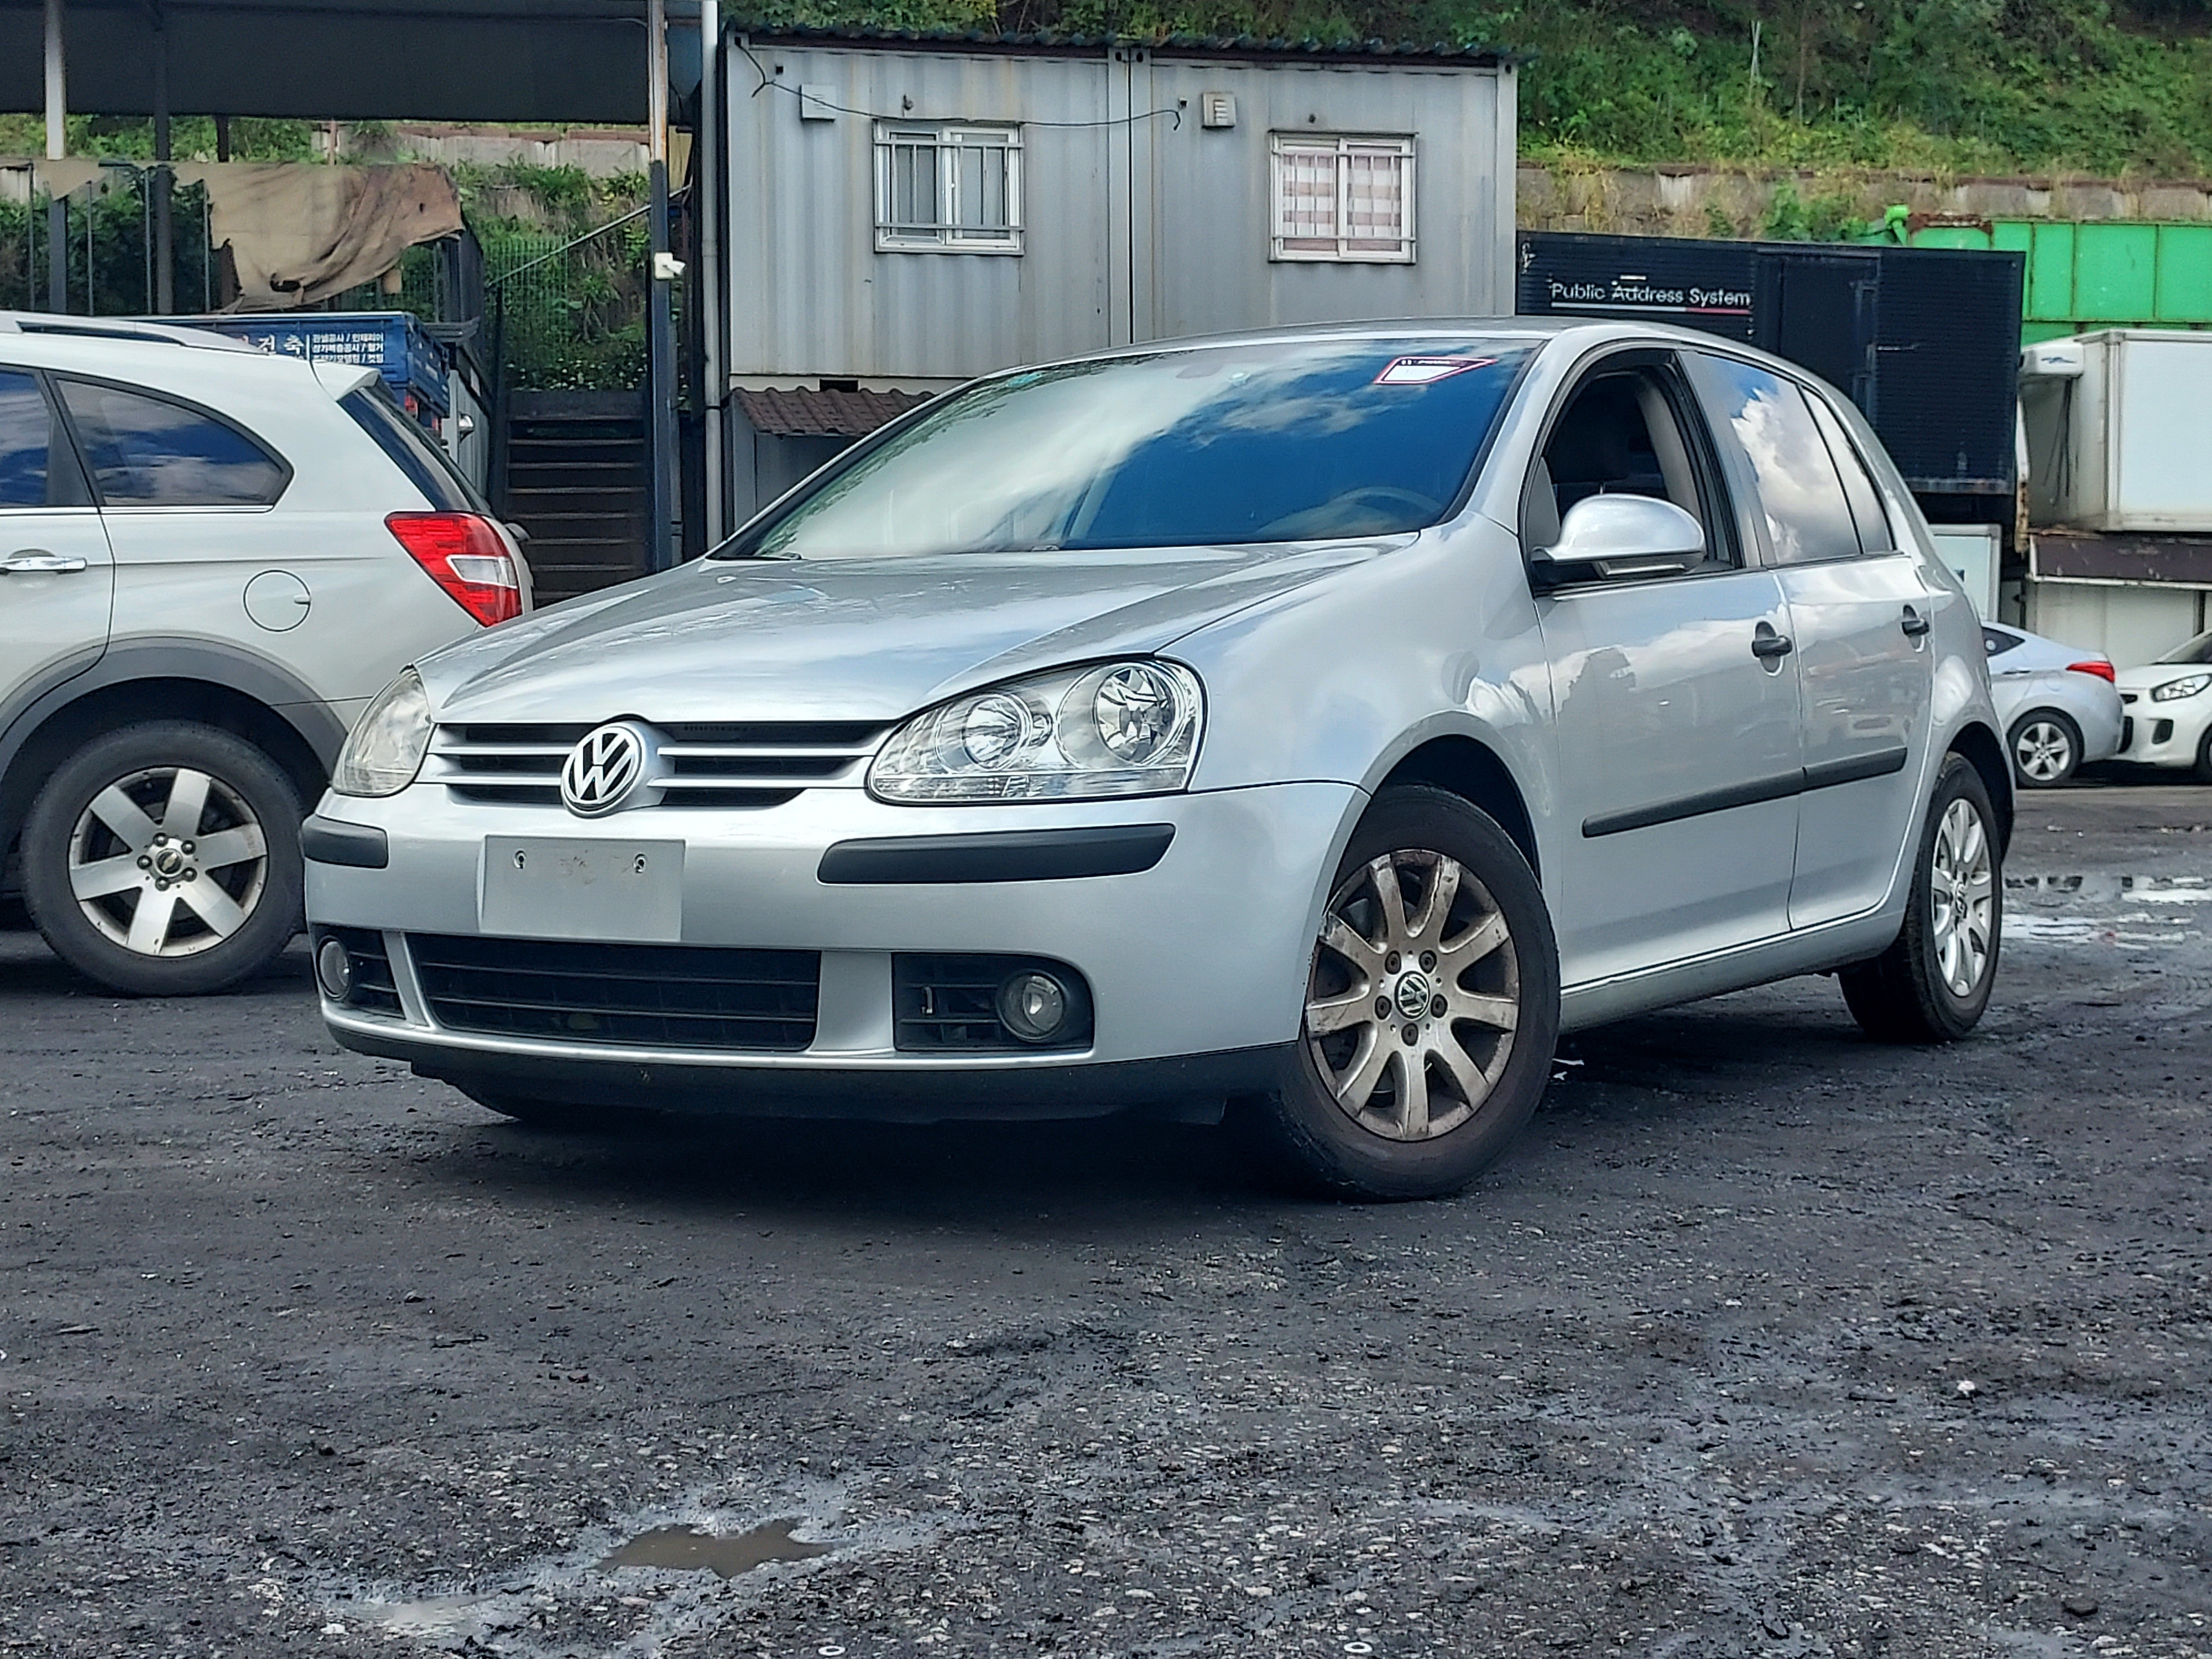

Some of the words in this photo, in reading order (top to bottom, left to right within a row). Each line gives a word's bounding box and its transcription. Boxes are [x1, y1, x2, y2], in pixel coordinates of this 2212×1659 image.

[1551, 283, 1605, 300] Public
[1612, 284, 1683, 303] Address
[1688, 287, 1750, 309] System
